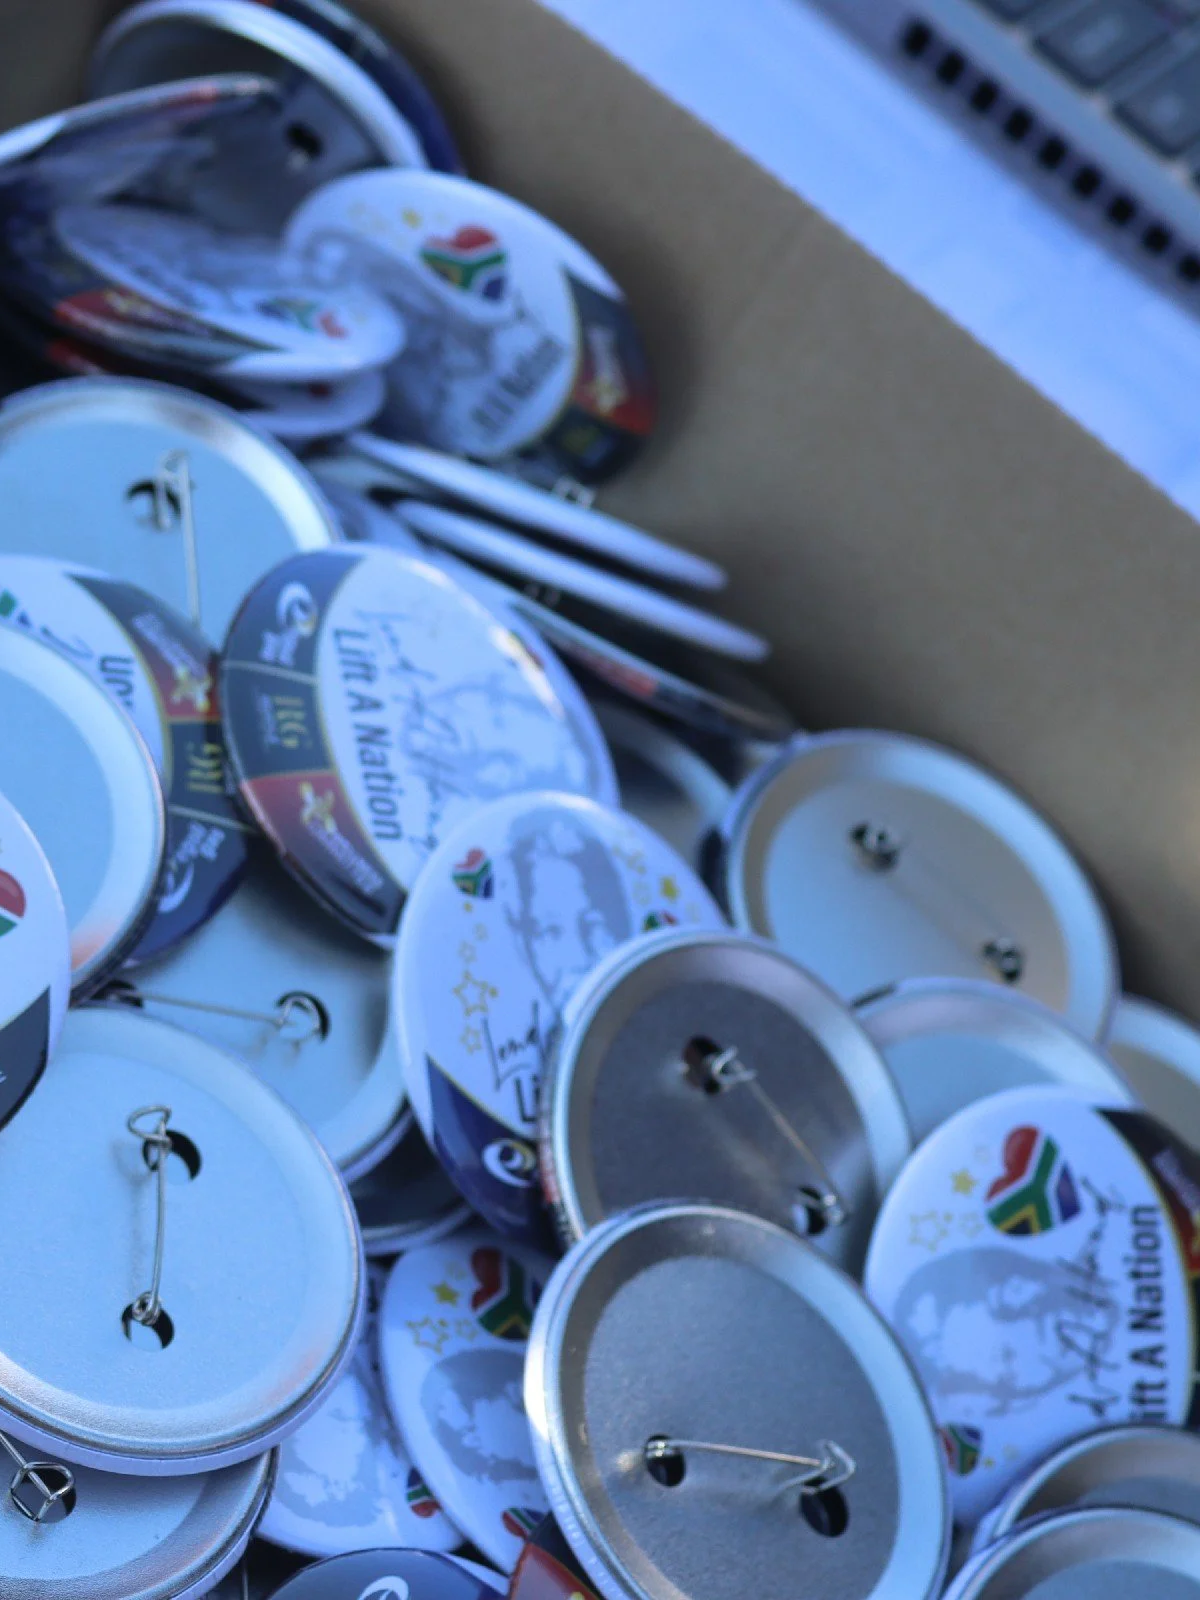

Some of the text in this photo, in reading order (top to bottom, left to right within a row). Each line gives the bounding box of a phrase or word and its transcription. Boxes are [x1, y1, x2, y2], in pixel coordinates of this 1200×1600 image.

[333, 627, 404, 842] Lift A Nation
[1123, 1204, 1165, 1333] Nation
[1128, 1344, 1169, 1370] A
